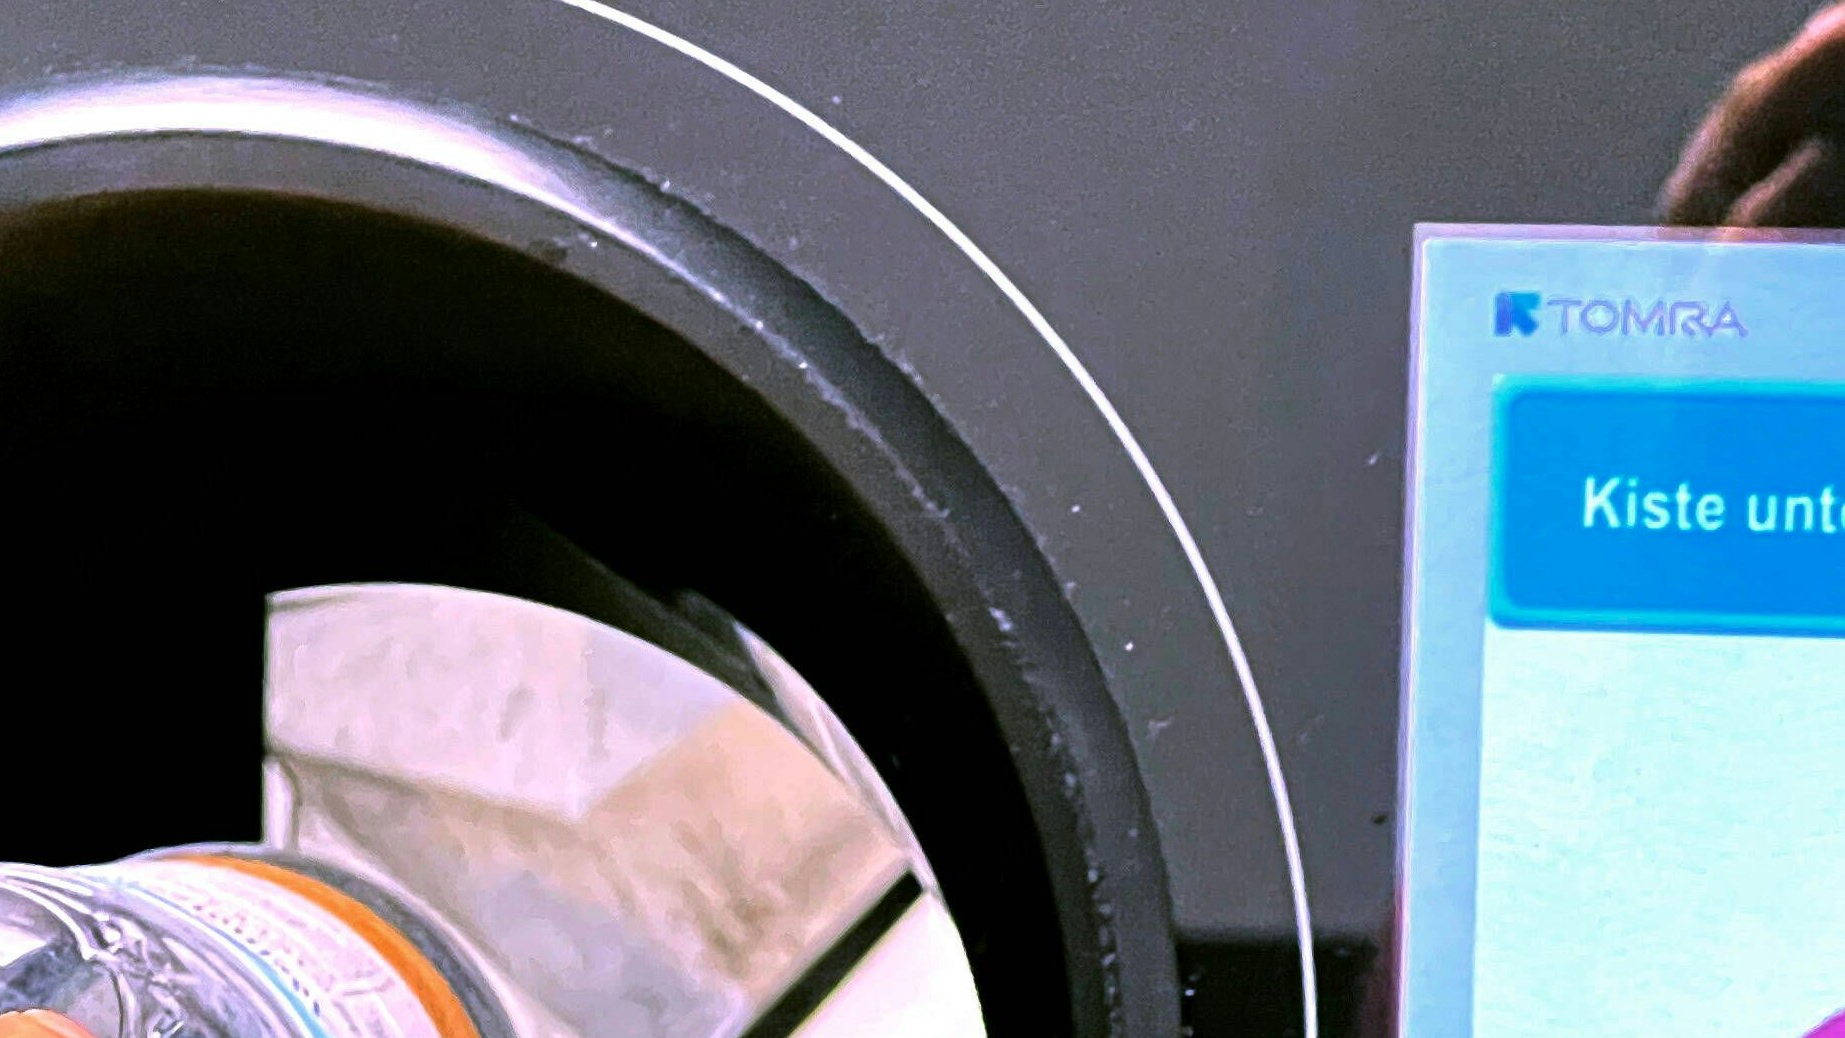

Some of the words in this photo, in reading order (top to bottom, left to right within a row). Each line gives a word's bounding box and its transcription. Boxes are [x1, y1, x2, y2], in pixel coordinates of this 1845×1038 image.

[1547, 298, 1749, 338] TOMRA
[1583, 476, 1725, 530] Kiste
[1748, 485, 1845, 533] unt
